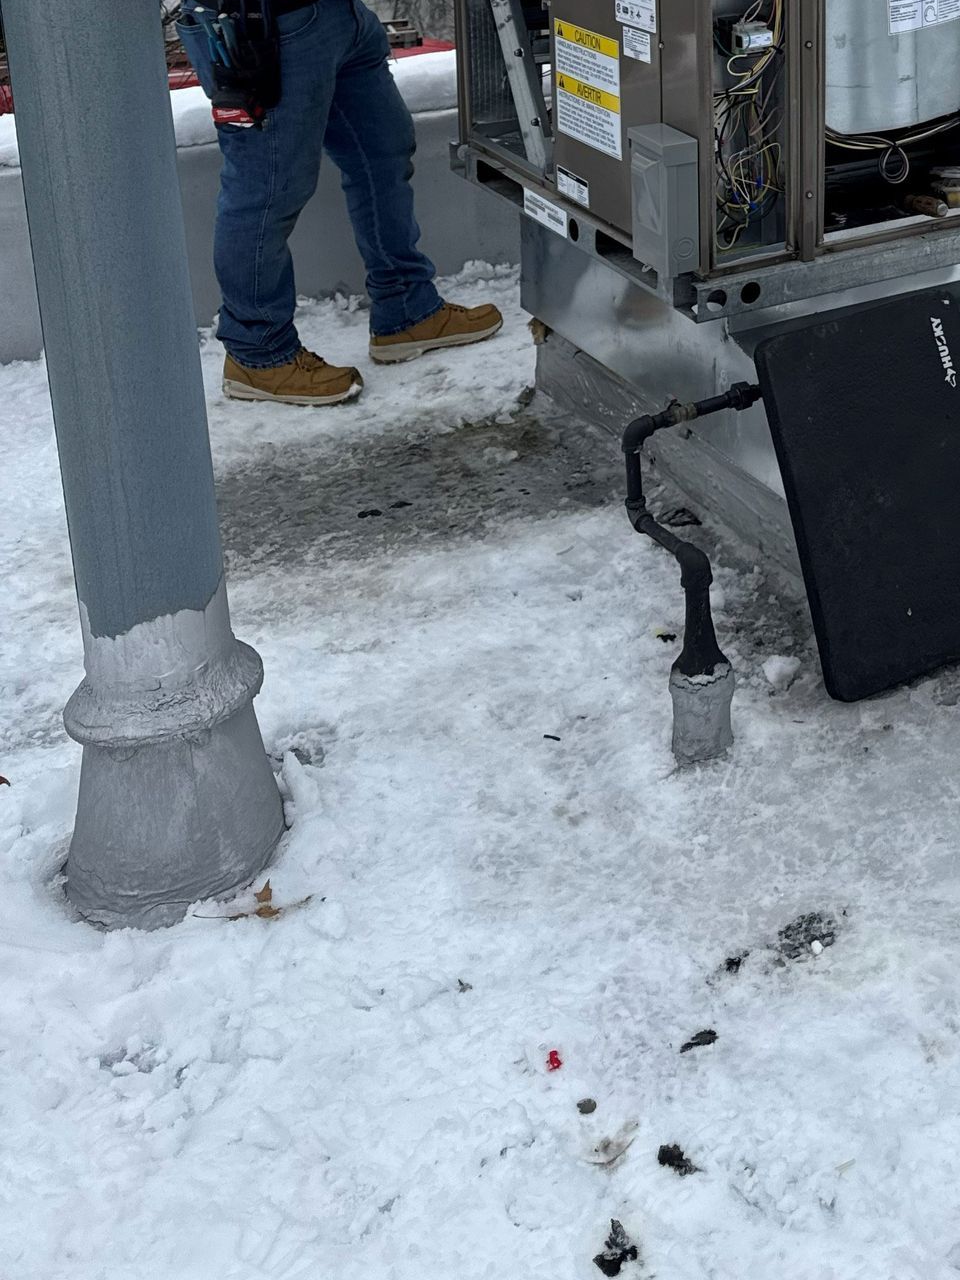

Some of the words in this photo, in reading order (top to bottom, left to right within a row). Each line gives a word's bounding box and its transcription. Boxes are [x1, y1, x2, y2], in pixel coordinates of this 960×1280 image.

[574, 29, 601, 51] CAUTION
[577, 82, 602, 104] AVERTIR
[930, 316, 953, 369] HUSKY
